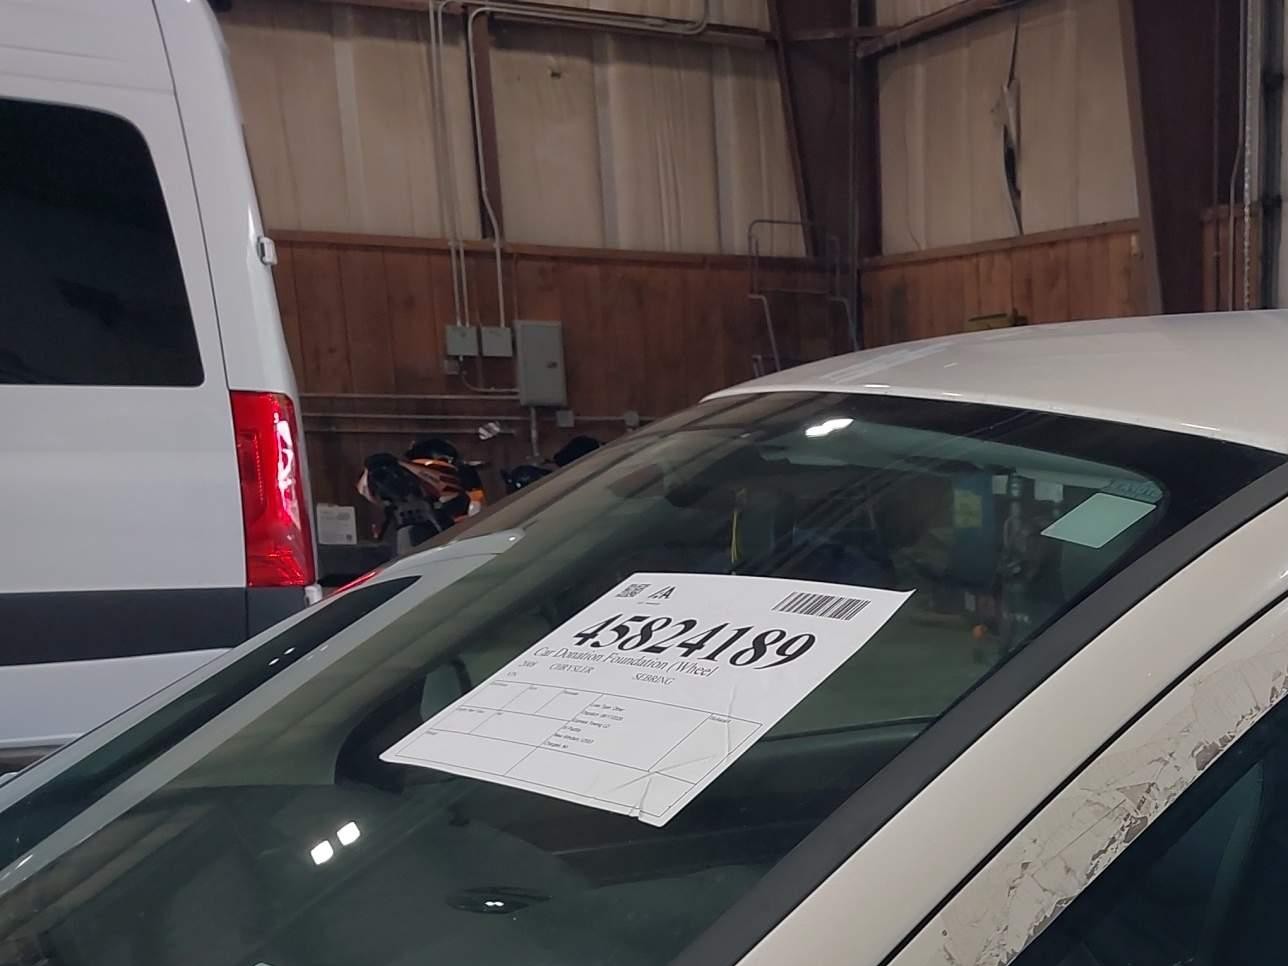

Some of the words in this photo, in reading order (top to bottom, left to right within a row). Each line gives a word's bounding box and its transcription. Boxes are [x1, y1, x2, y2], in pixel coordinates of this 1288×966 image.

[573, 613, 816, 670] 45824189
[533, 646, 557, 657] Car
[553, 647, 606, 662] Donation
[603, 651, 669, 671] Foundation
[667, 660, 719, 678] (Wheel
[632, 672, 675, 685] SEBRING
